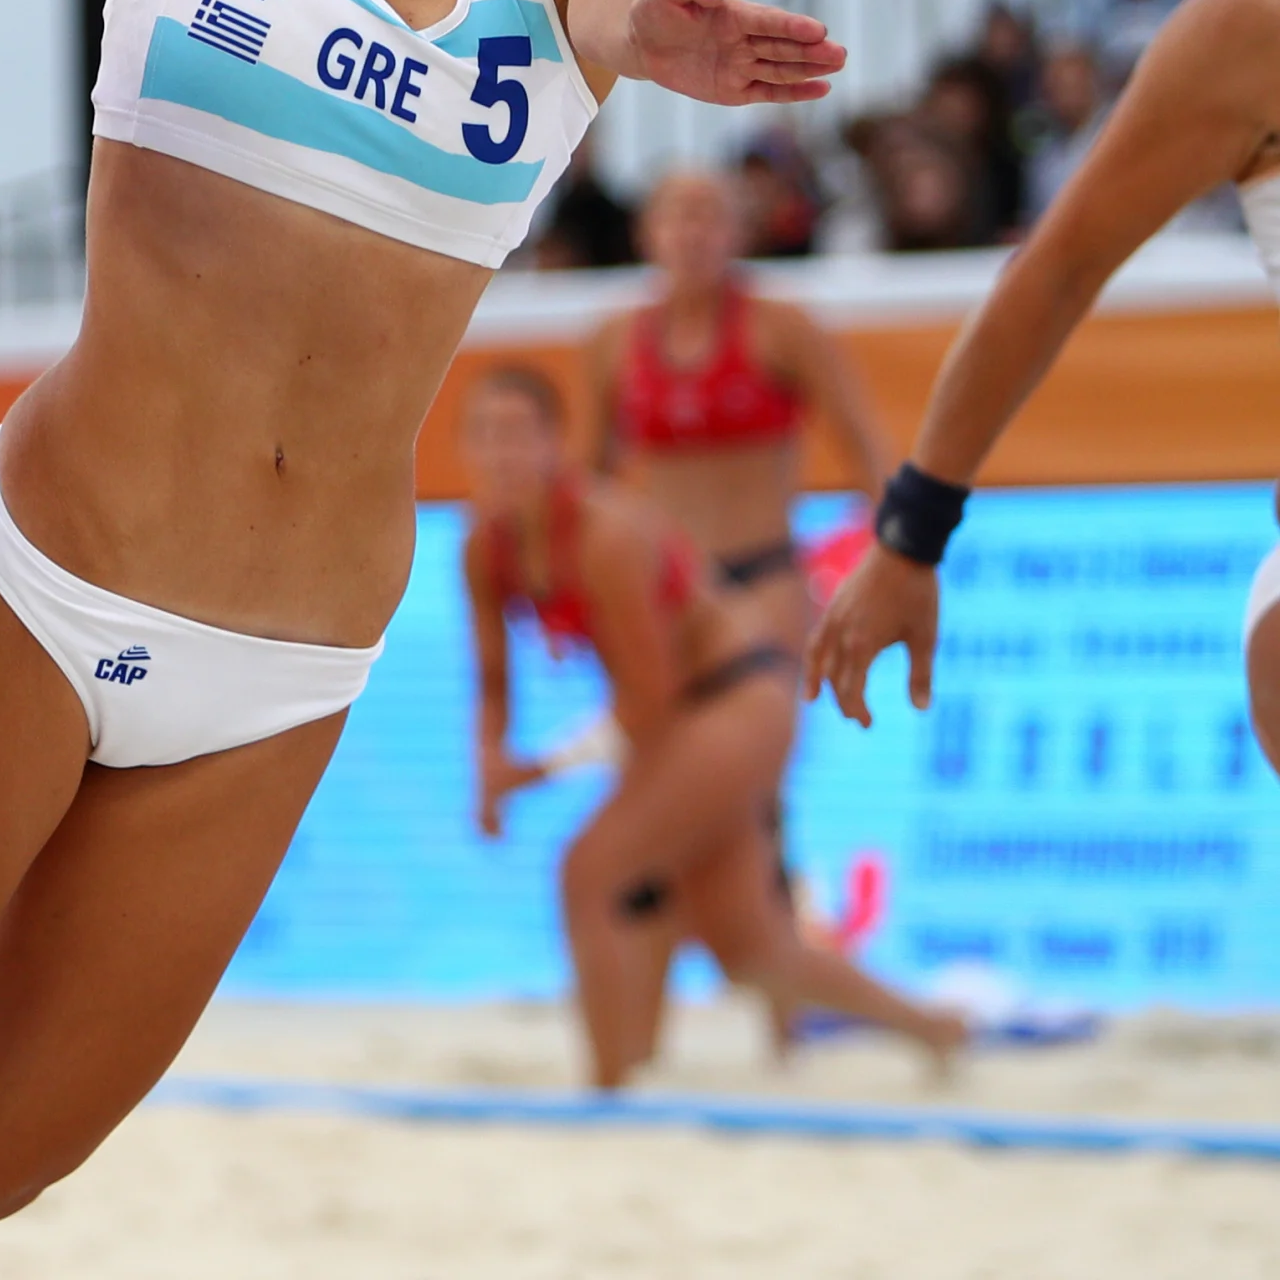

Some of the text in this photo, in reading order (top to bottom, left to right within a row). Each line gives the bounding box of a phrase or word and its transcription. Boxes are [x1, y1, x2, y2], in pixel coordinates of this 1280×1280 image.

[316, 27, 429, 124] GRE
[460, 35, 533, 165] 5
[94, 658, 148, 686] CAP
